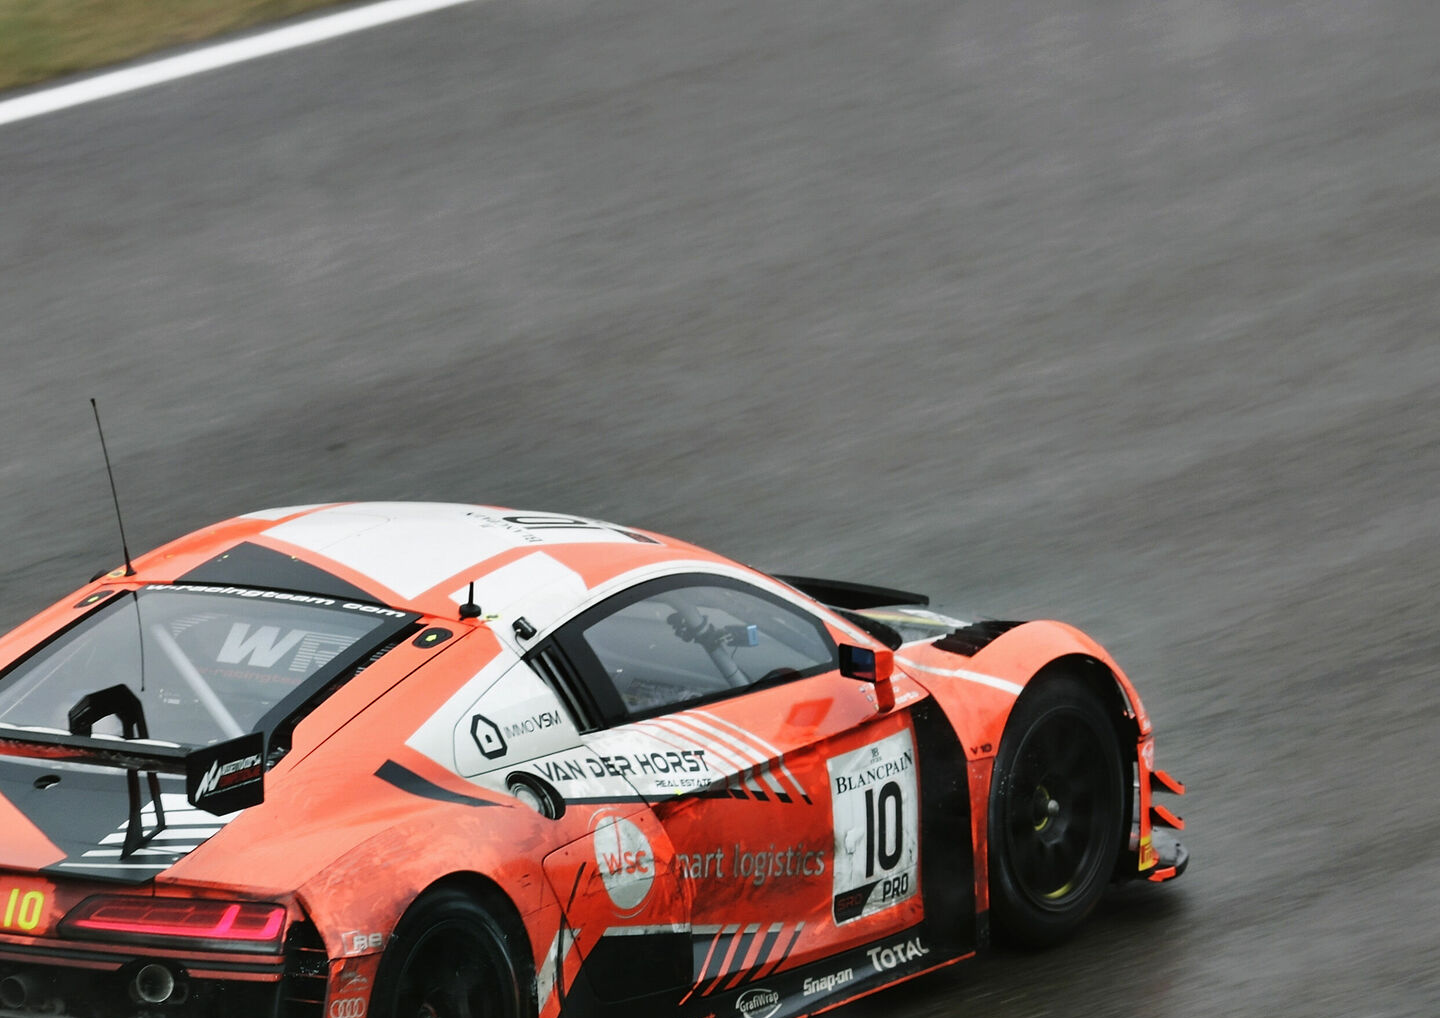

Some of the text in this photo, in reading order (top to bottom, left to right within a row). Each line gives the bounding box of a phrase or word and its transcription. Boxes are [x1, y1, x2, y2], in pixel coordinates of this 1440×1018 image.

[216, 622, 360, 673] WR
[533, 750, 711, 782] VAN DER HORST
[835, 748, 914, 795] BLANCPAIN
[864, 780, 903, 879] 10
[602, 850, 650, 876] WSC
[734, 843, 826, 887] logistics
[882, 873, 910, 902] PRO
[3, 887, 45, 931] 10
[867, 937, 931, 974] TOTAL
[803, 967, 854, 997] Snap-on
[739, 991, 780, 1013] GrafiWrap
